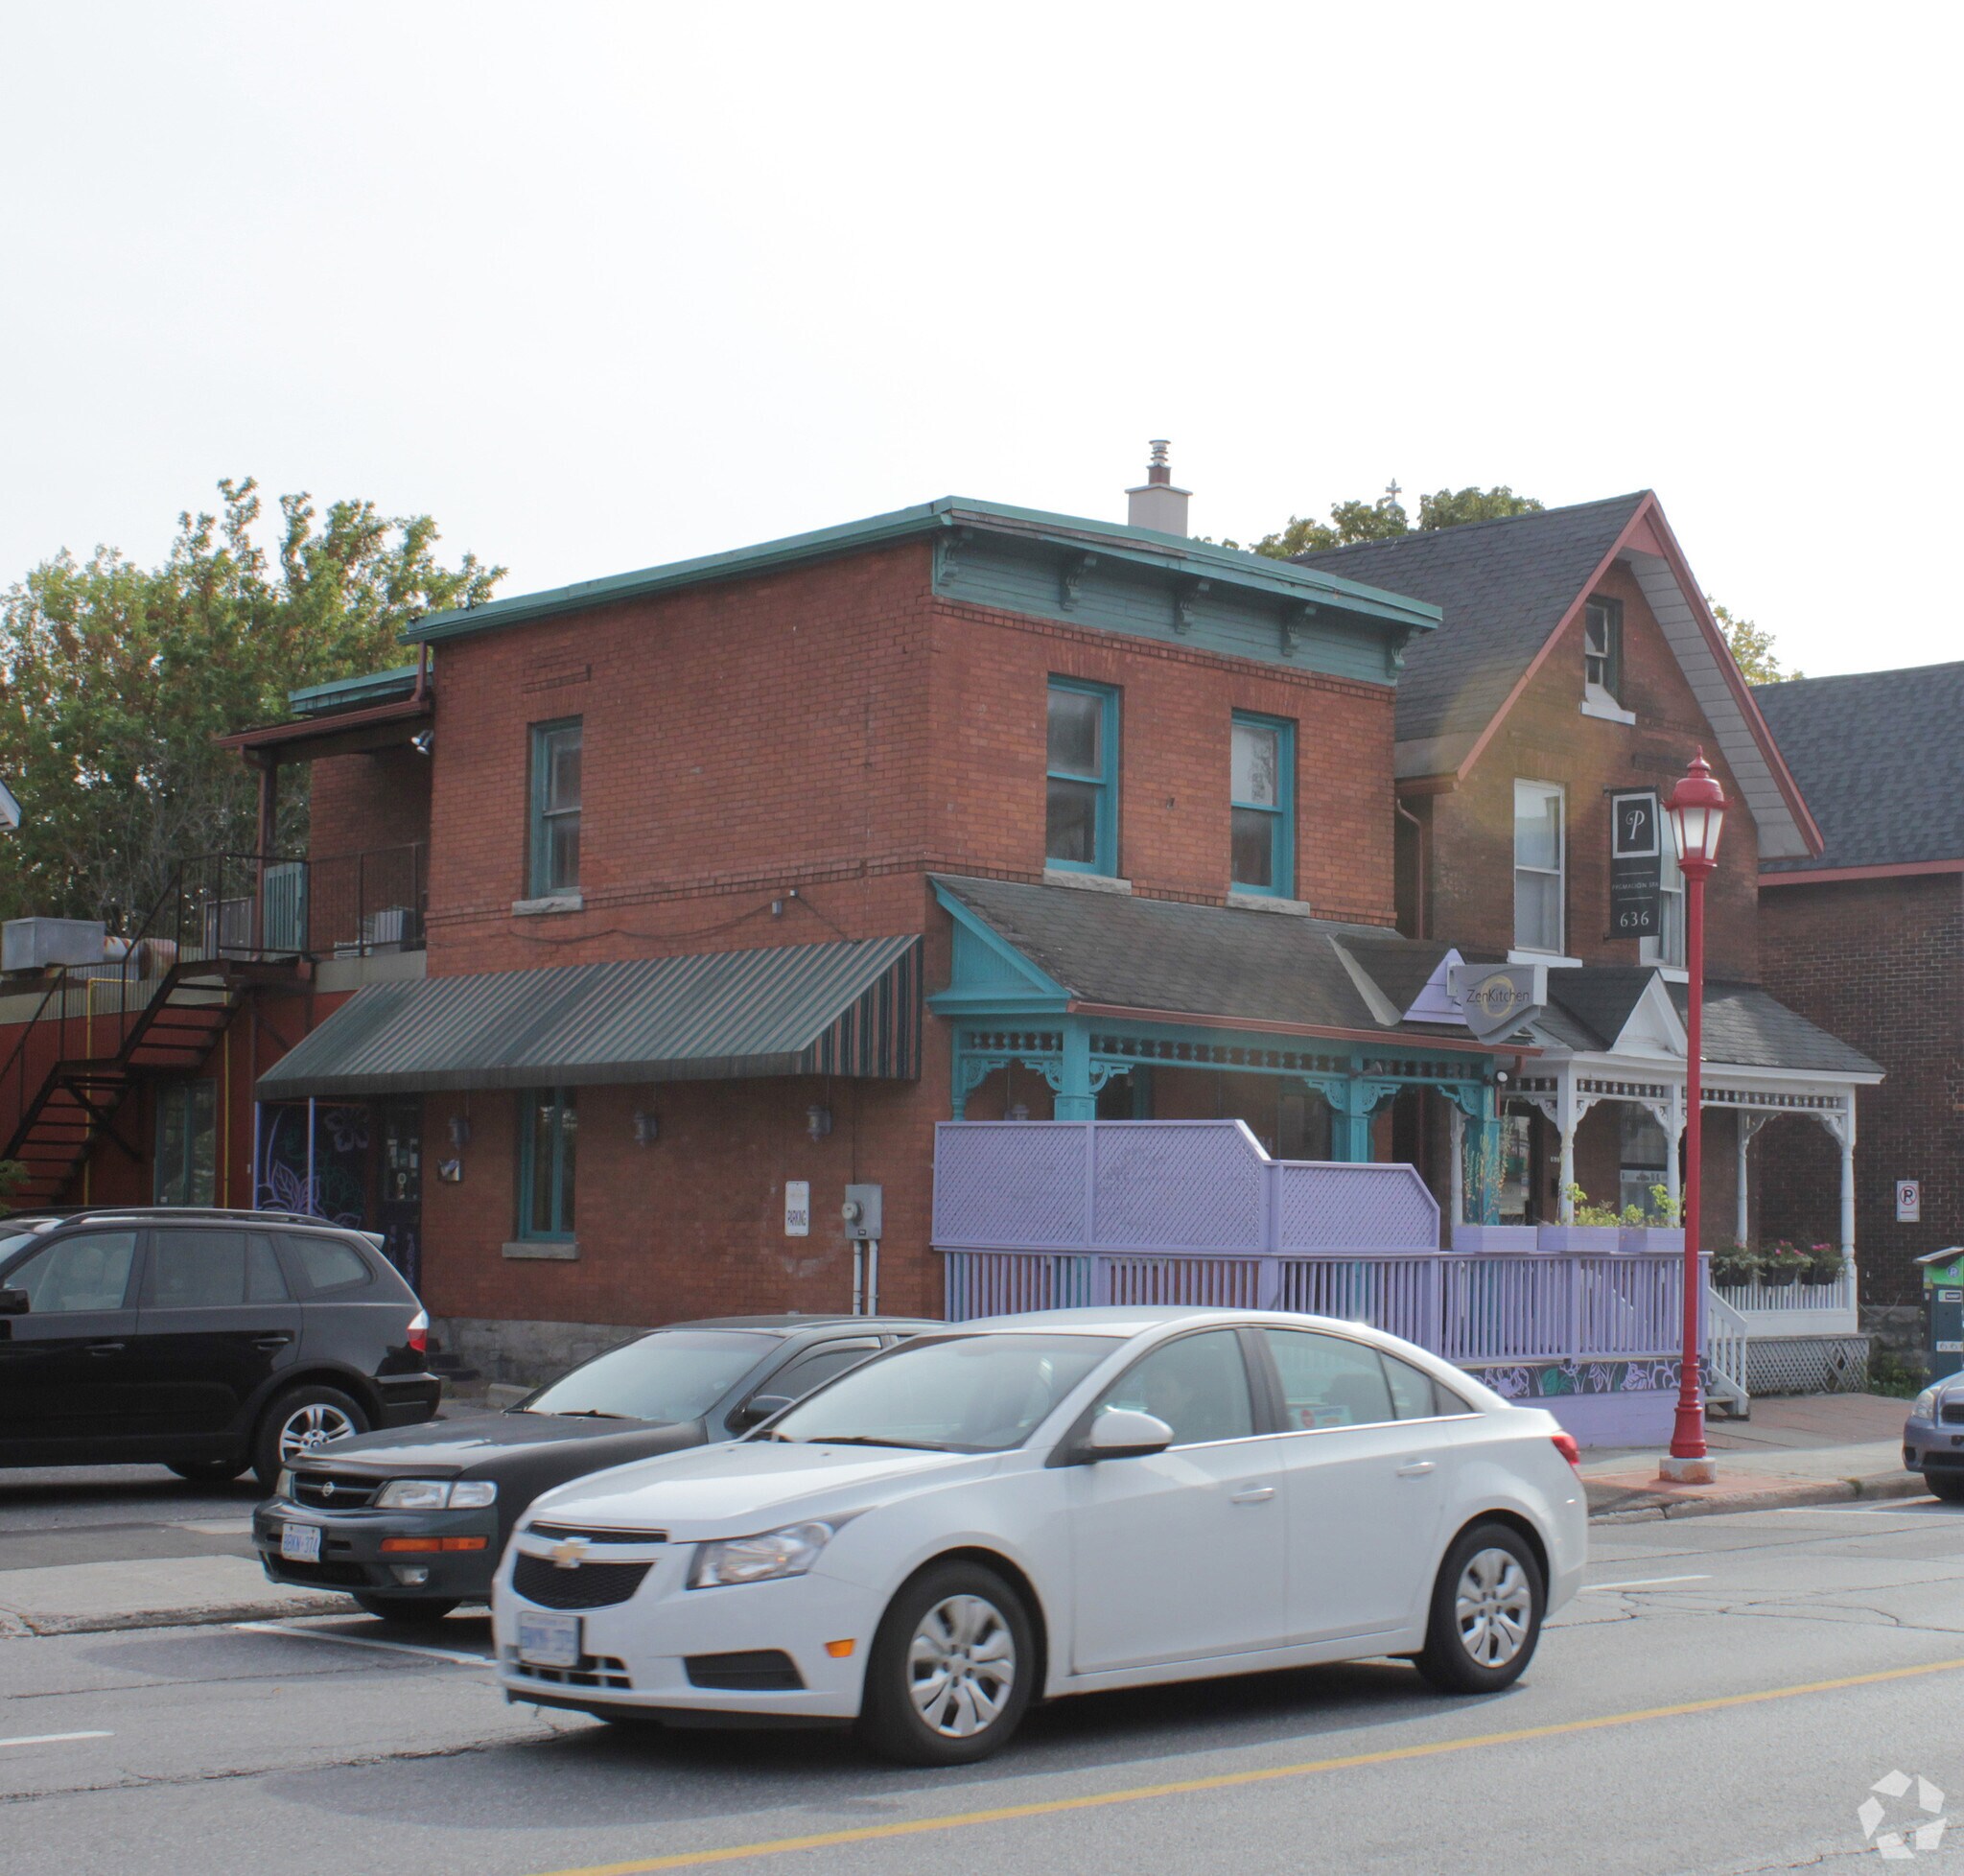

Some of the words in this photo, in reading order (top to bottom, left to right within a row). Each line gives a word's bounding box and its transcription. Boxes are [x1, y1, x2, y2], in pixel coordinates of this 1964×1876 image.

[1625, 809, 1646, 840] P
[1620, 911, 1649, 927] 636
[1466, 988, 1530, 1003] ZenKitchen
[787, 1209, 807, 1227] PARKING
